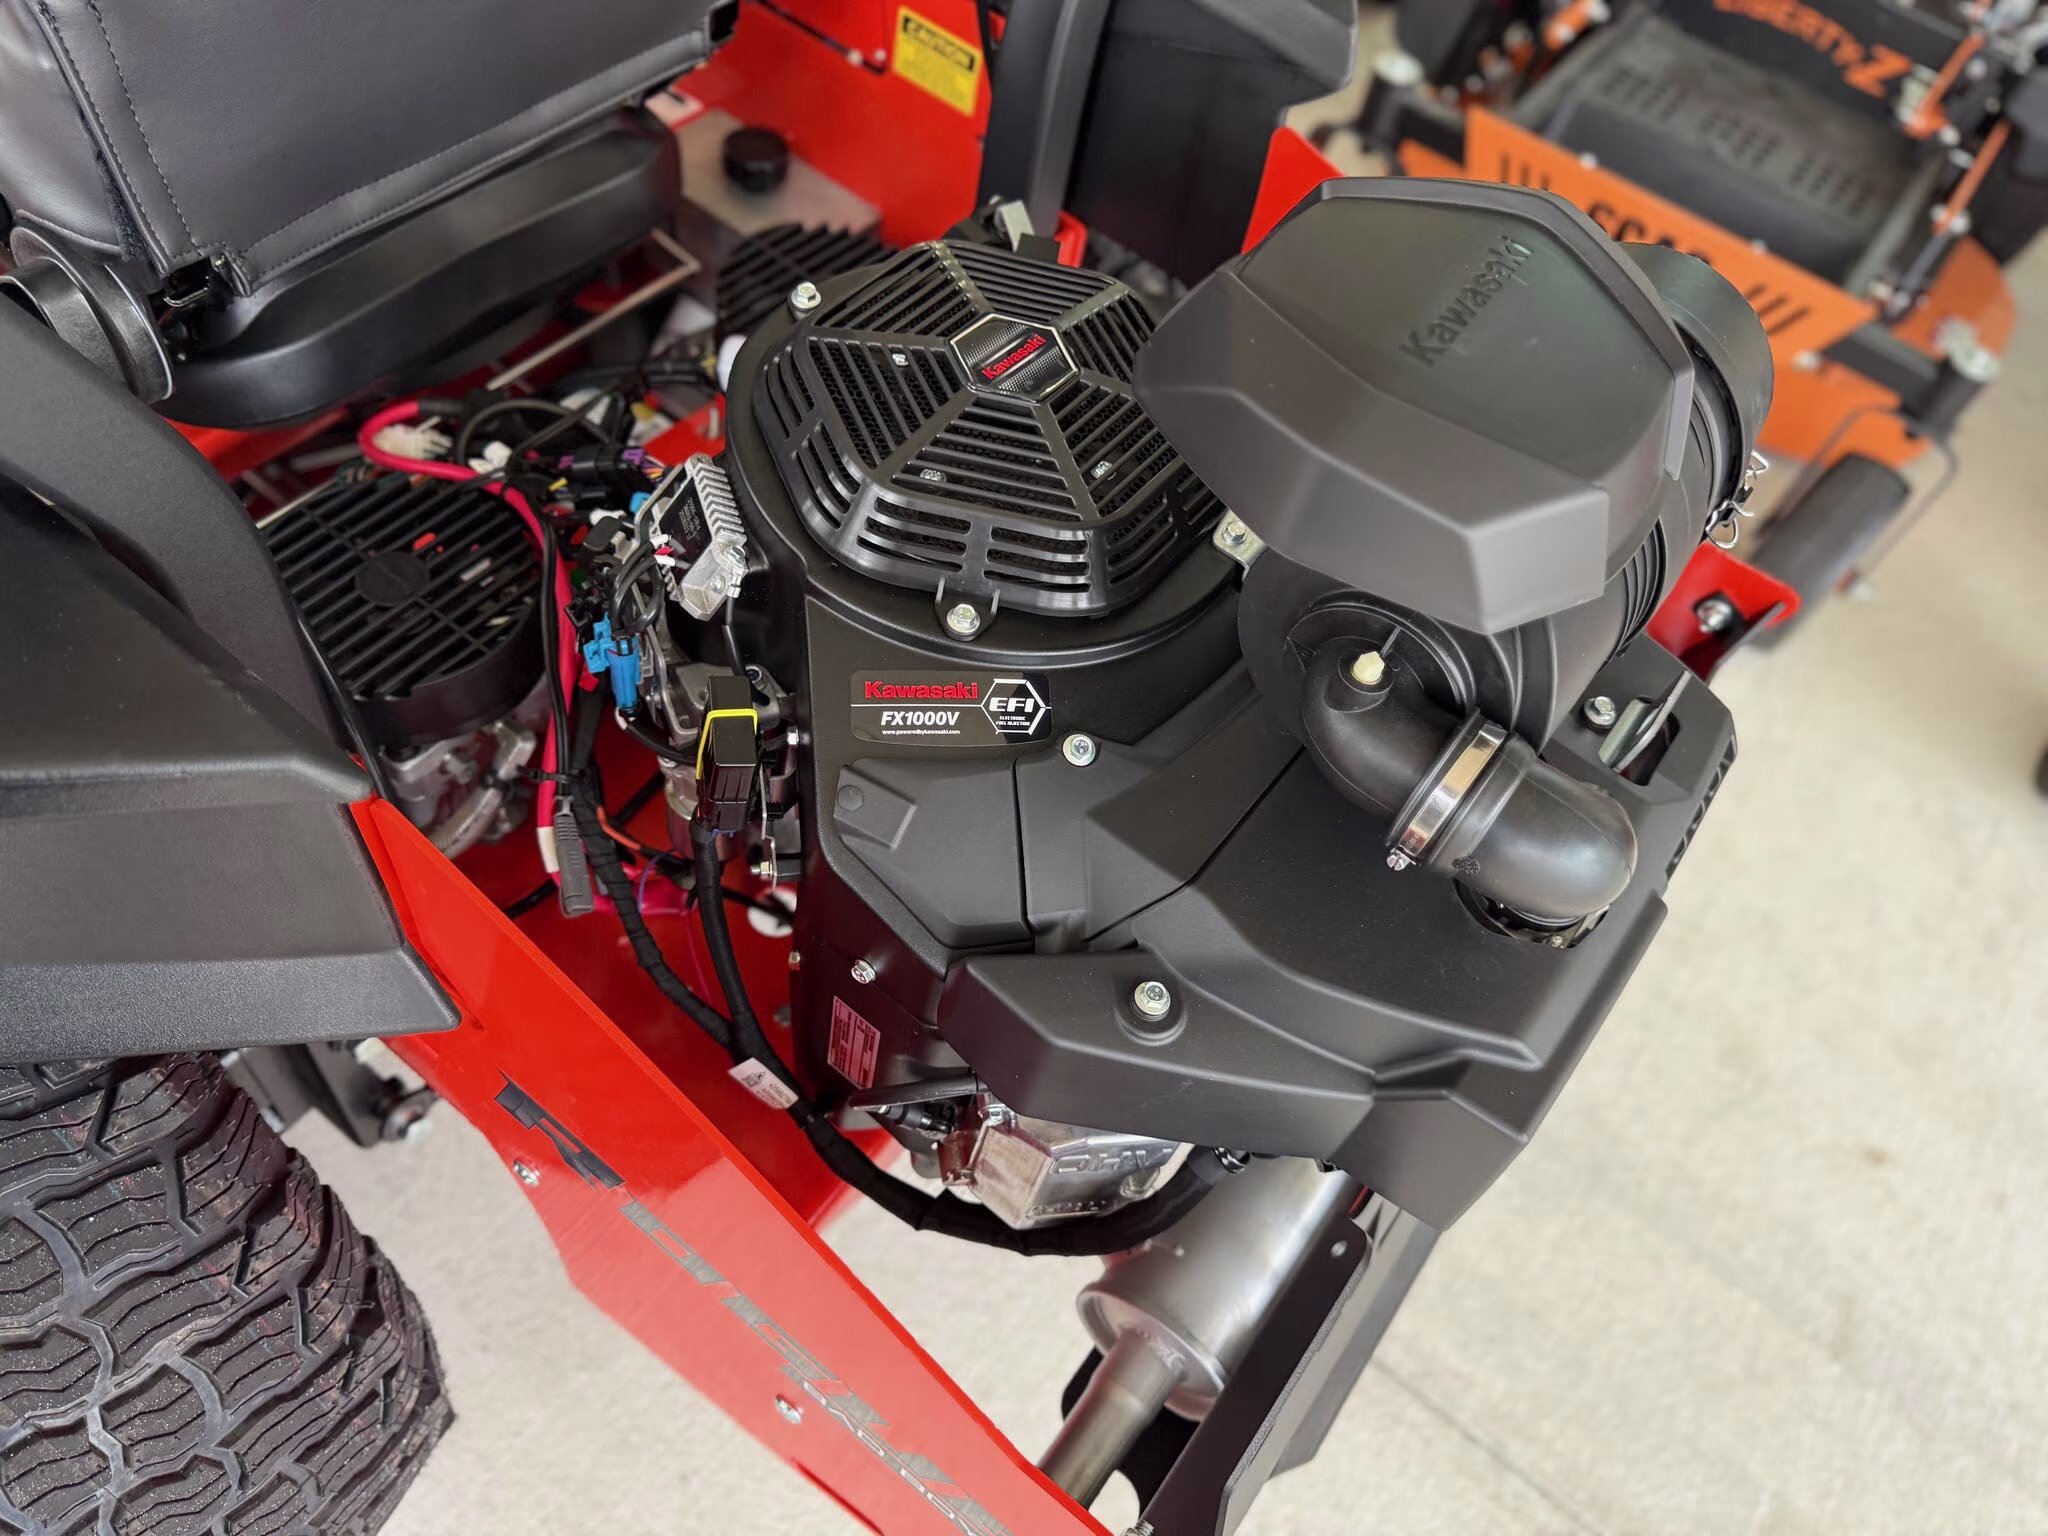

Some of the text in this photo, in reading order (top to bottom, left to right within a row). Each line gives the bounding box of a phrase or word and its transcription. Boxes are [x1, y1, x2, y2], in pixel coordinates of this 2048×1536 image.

[1399, 235, 1533, 367] Kawasaki
[981, 332, 1046, 380] Kawasaki
[864, 681, 979, 699] Kawasaki
[989, 697, 1035, 713] EFI
[880, 711, 961, 726] FX1000V
[803, 1380, 885, 1457] BAD
